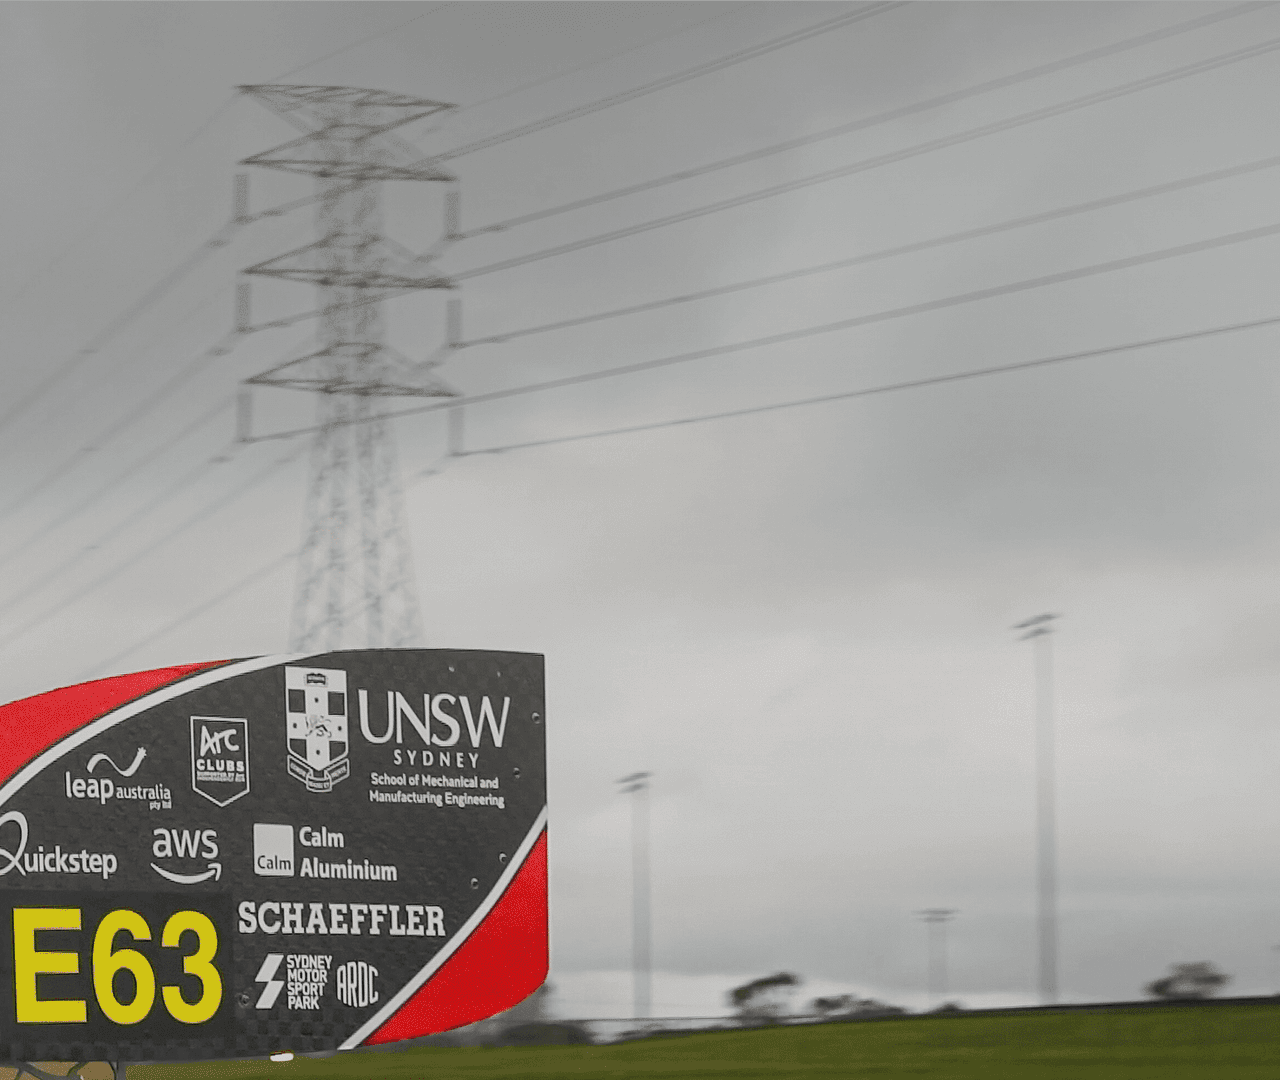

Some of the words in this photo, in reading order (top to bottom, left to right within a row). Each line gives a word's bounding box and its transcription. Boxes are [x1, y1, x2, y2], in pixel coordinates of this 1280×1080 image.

[358, 689, 510, 748] UNSW
[196, 759, 245, 772] CLUBS
[393, 749, 479, 768] SYDNEY
[65, 771, 114, 805] leap
[116, 783, 171, 800] australia
[371, 772, 406, 786] School
[408, 774, 421, 786] of
[423, 775, 478, 788] Mechanical
[479, 777, 499, 789] and
[369, 790, 443, 807] Manufacturing
[445, 792, 505, 809] Engineering
[152, 828, 219, 859] aws
[299, 826, 344, 848] Calm
[257, 855, 292, 870] Calm
[300, 857, 397, 881] Aluminium
[238, 901, 446, 936] SCHAEFFLER
[13, 908, 222, 1024] E63
[286, 954, 332, 970] SYDNEY
[287, 968, 328, 983] MOTOR
[336, 961, 379, 1007] ARDC
[287, 982, 325, 996] SPORT
[287, 996, 320, 1010] PARK
